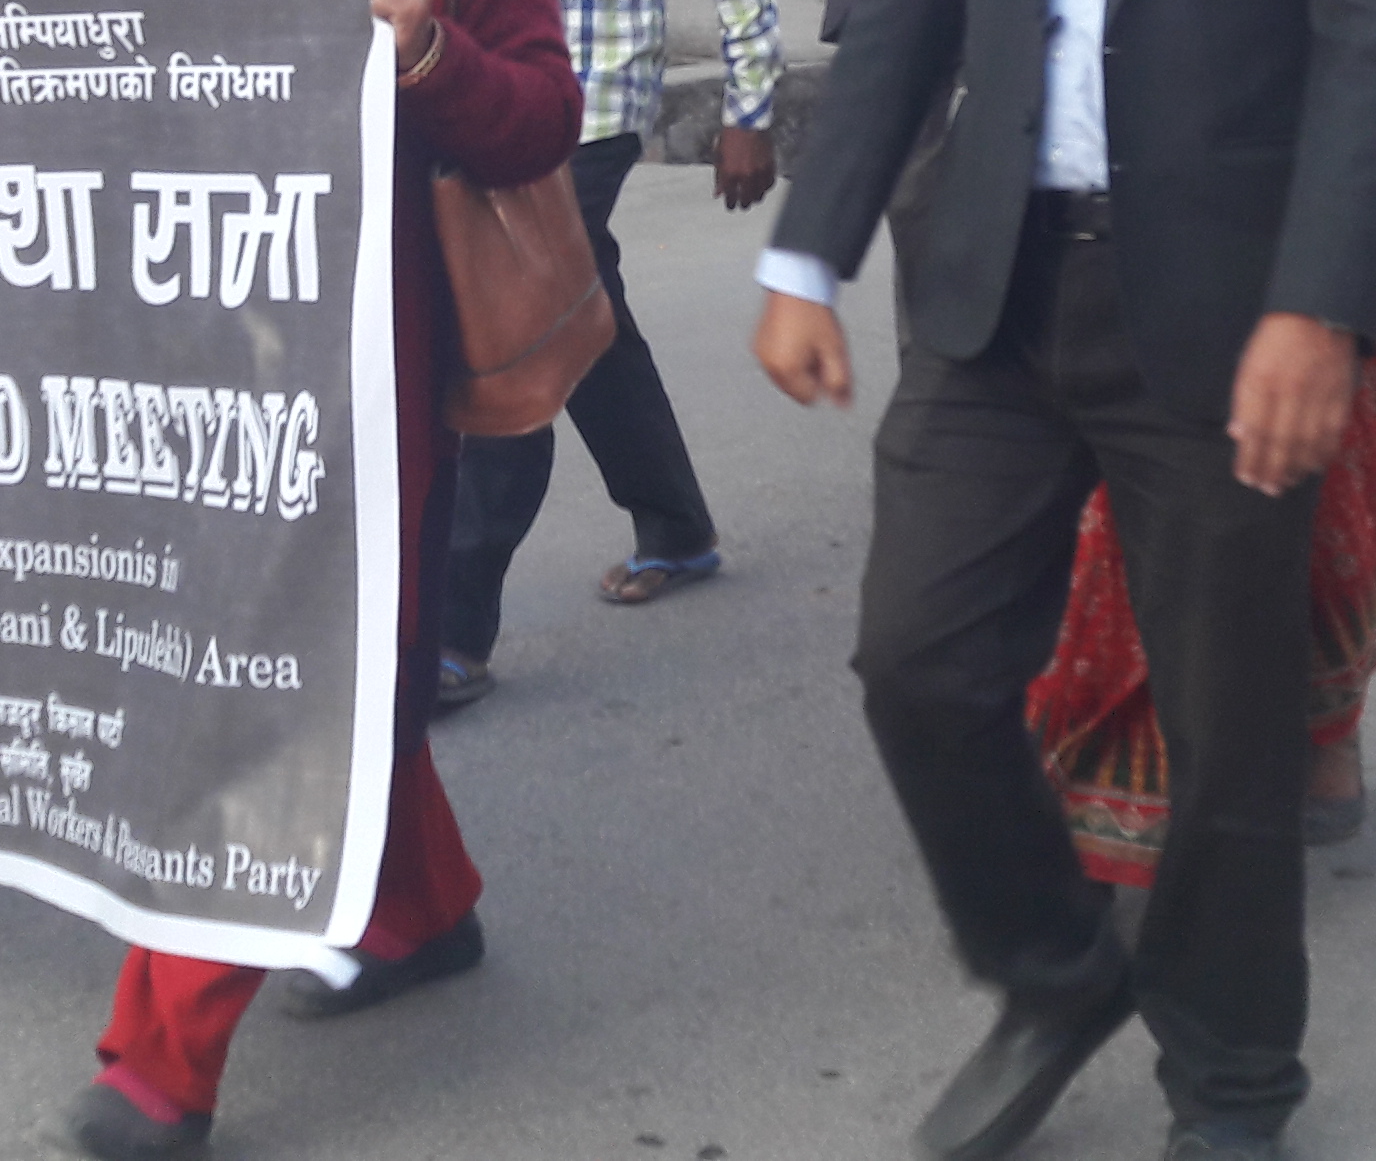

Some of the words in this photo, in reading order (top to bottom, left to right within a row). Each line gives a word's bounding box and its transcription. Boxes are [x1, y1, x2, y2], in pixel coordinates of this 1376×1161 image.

[166, 51, 296, 108] विरोधमा
[130, 171, 332, 309] सभा
[40, 375, 326, 521] MEETING
[60, 603, 89, 652] &
[195, 635, 301, 690] Area
[24, 783, 104, 853] Workers
[222, 842, 322, 911] Party
